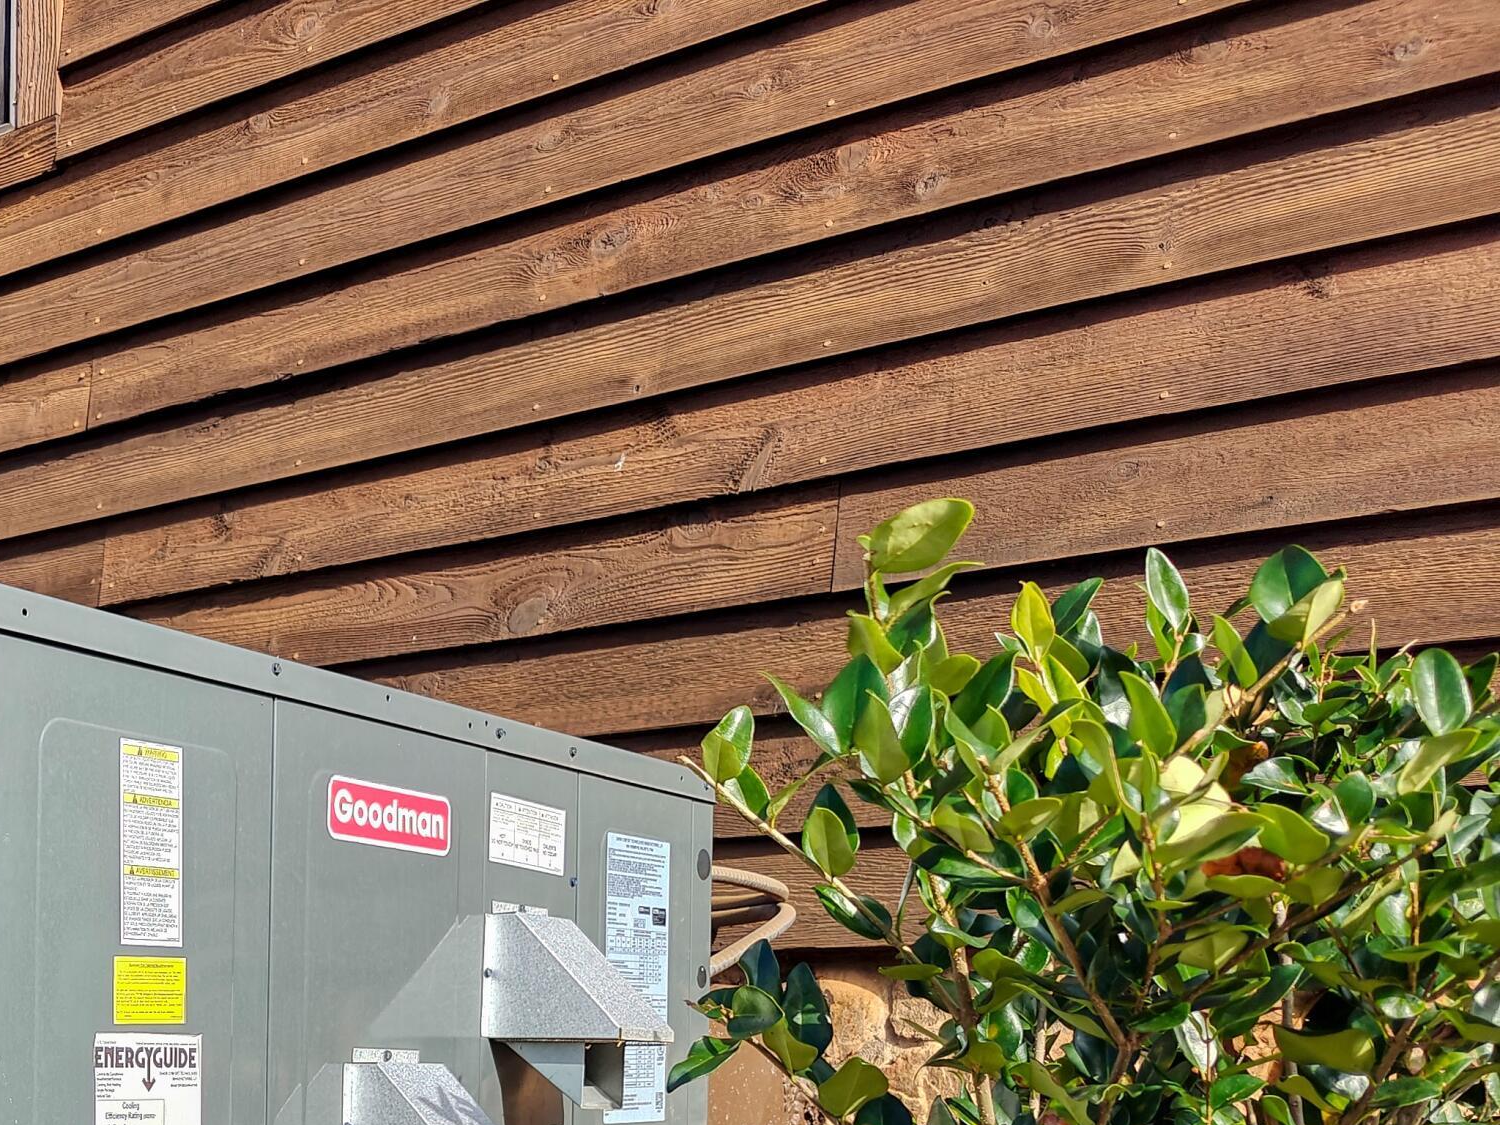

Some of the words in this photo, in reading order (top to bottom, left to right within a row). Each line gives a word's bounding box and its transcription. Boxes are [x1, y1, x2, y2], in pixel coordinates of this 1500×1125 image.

[334, 788, 445, 841] Goodman
[95, 1046, 197, 1069] ENERGYGUIDE
[122, 1102, 140, 1111] Cooling
